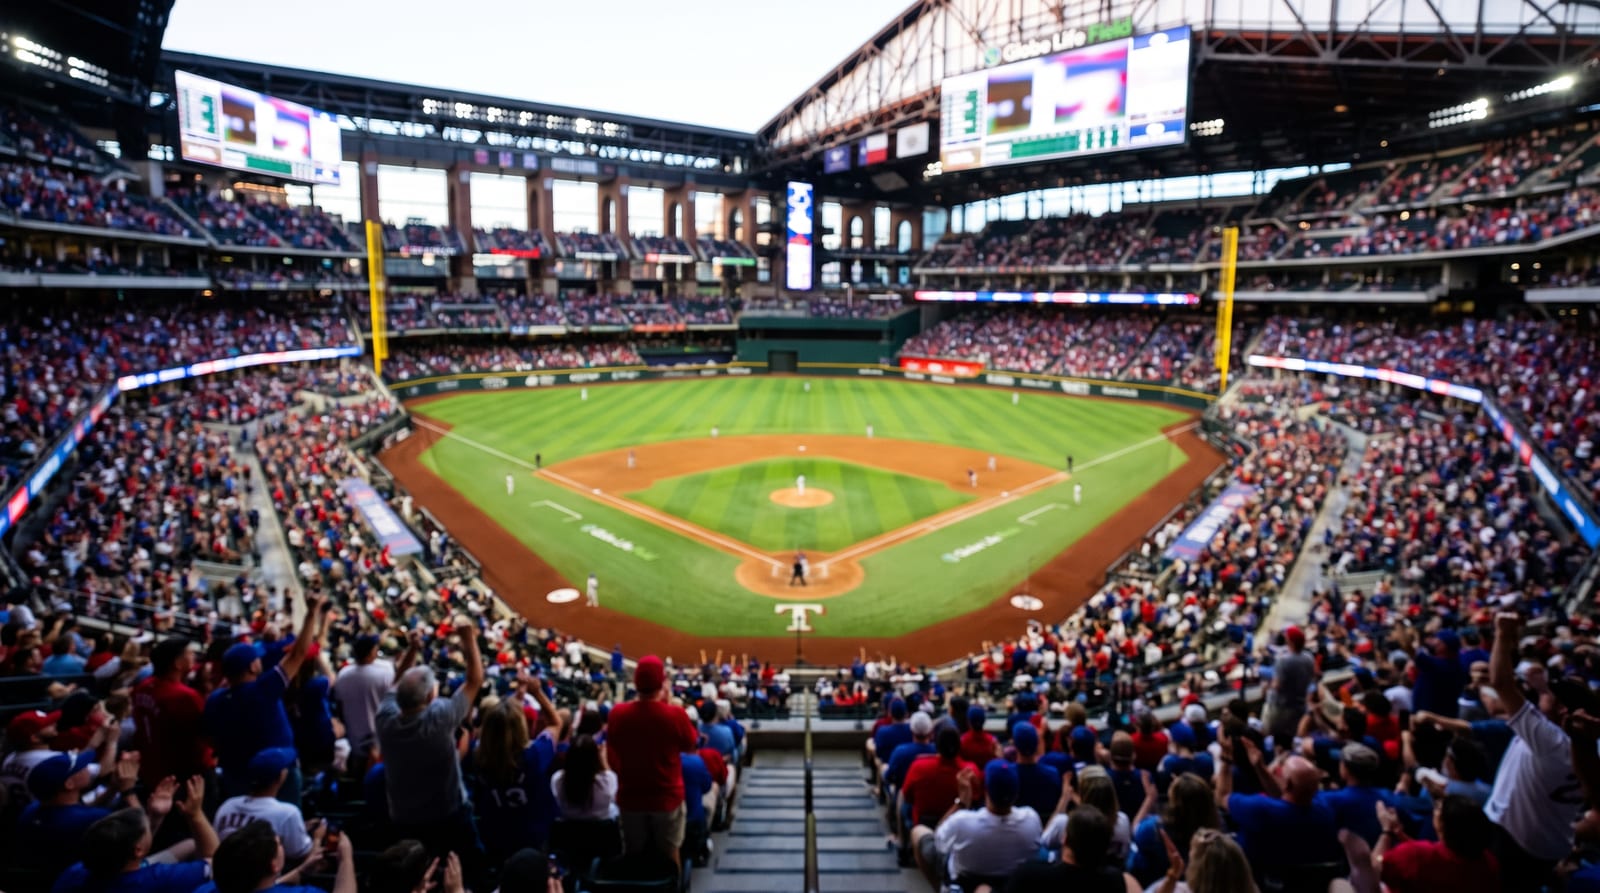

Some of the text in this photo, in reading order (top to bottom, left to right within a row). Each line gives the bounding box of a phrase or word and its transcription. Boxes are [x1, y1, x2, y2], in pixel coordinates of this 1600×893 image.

[1052, 29, 1086, 51] Life
[1087, 15, 1133, 43] Field
[774, 603, 826, 632] T
